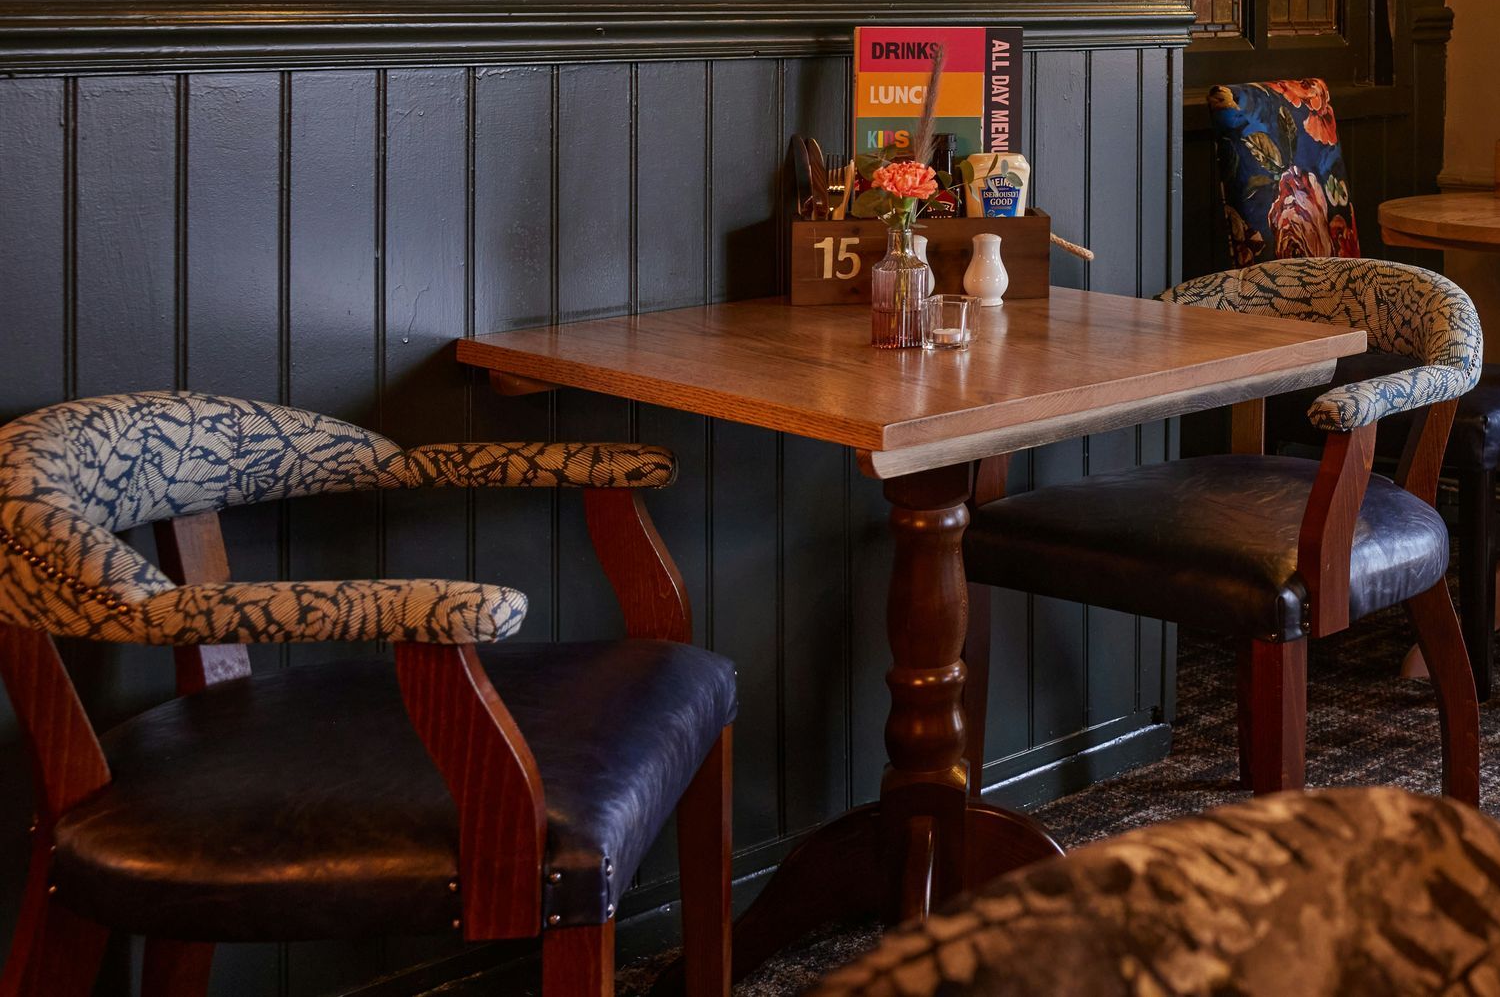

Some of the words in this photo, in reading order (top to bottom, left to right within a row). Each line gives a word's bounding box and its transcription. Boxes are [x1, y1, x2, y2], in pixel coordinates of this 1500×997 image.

[871, 42, 940, 60] DRINKS
[992, 39, 1010, 71] ALL
[991, 75, 1009, 105] DAY
[990, 198, 1013, 206] GOOD
[814, 237, 861, 280] 15
